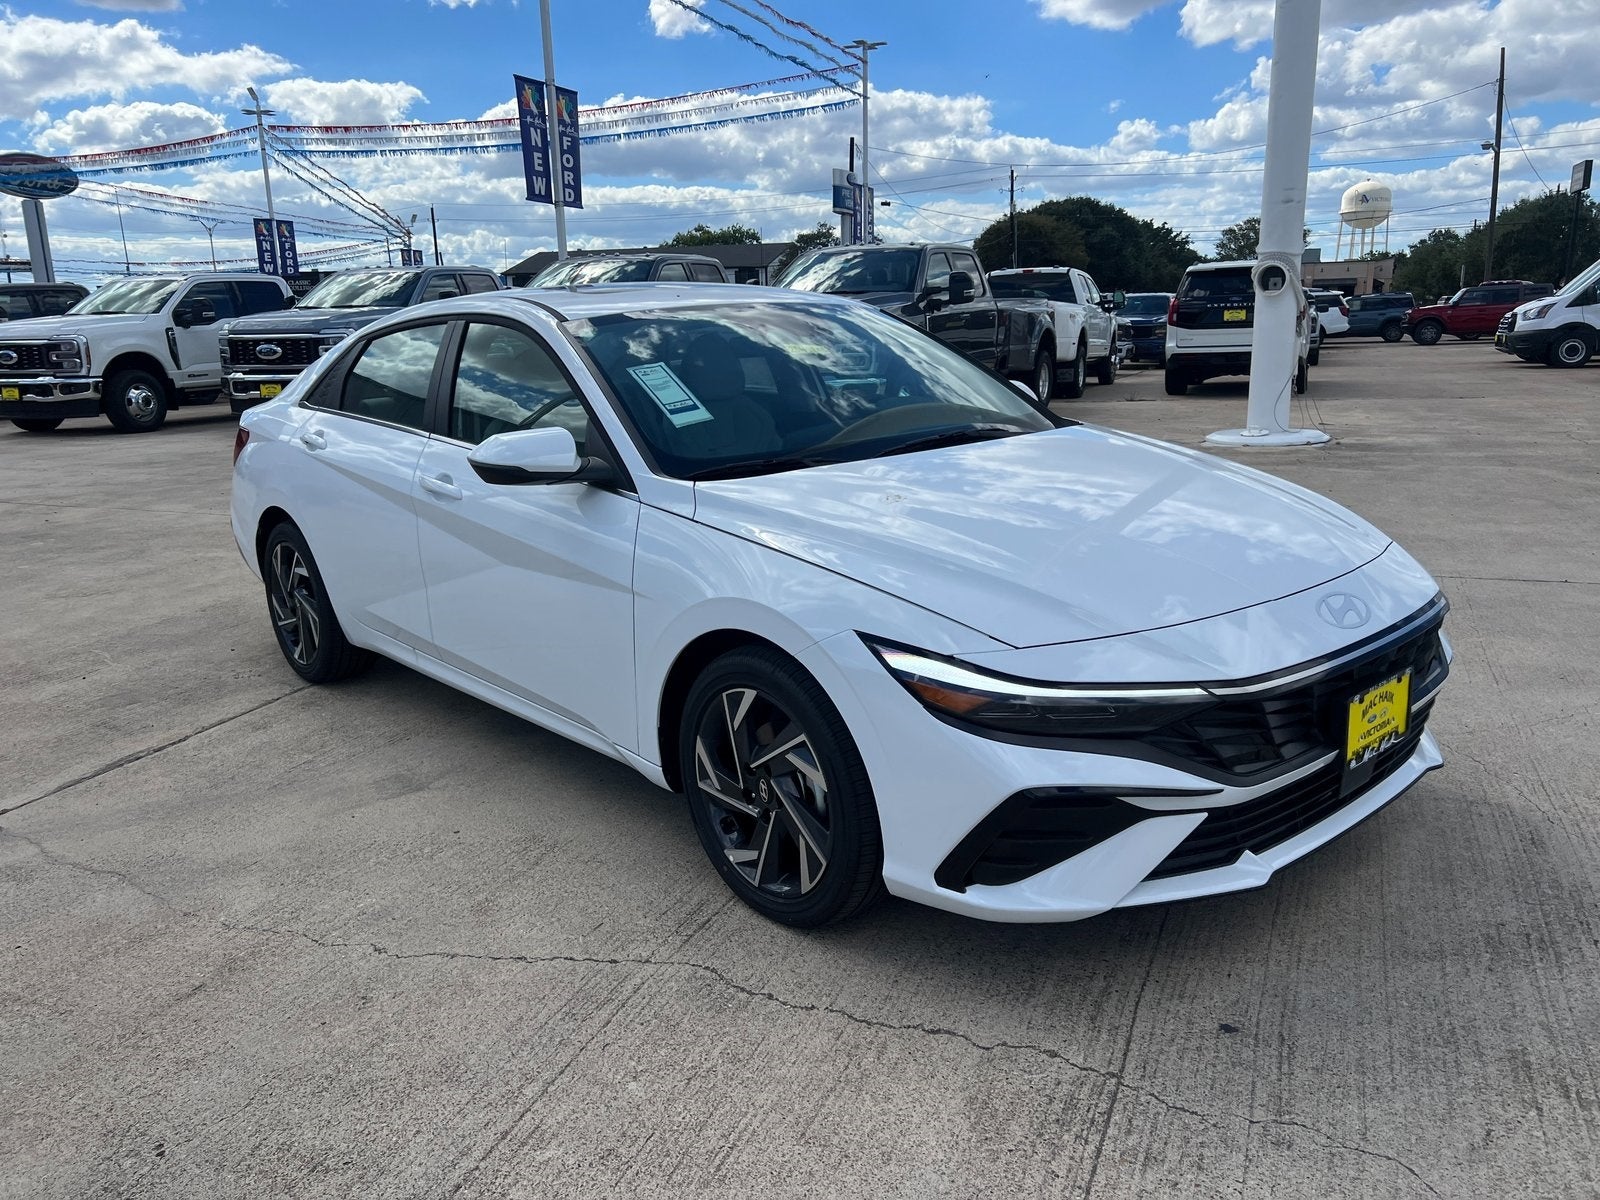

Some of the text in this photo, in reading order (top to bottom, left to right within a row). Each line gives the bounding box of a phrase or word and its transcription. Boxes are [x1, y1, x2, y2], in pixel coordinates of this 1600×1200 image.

[530, 127, 546, 196] NEW
[562, 136, 575, 202] FORD
[262, 240, 274, 273] NEW
[284, 242, 295, 274] FORD
[1361, 694, 1378, 722] MAC
